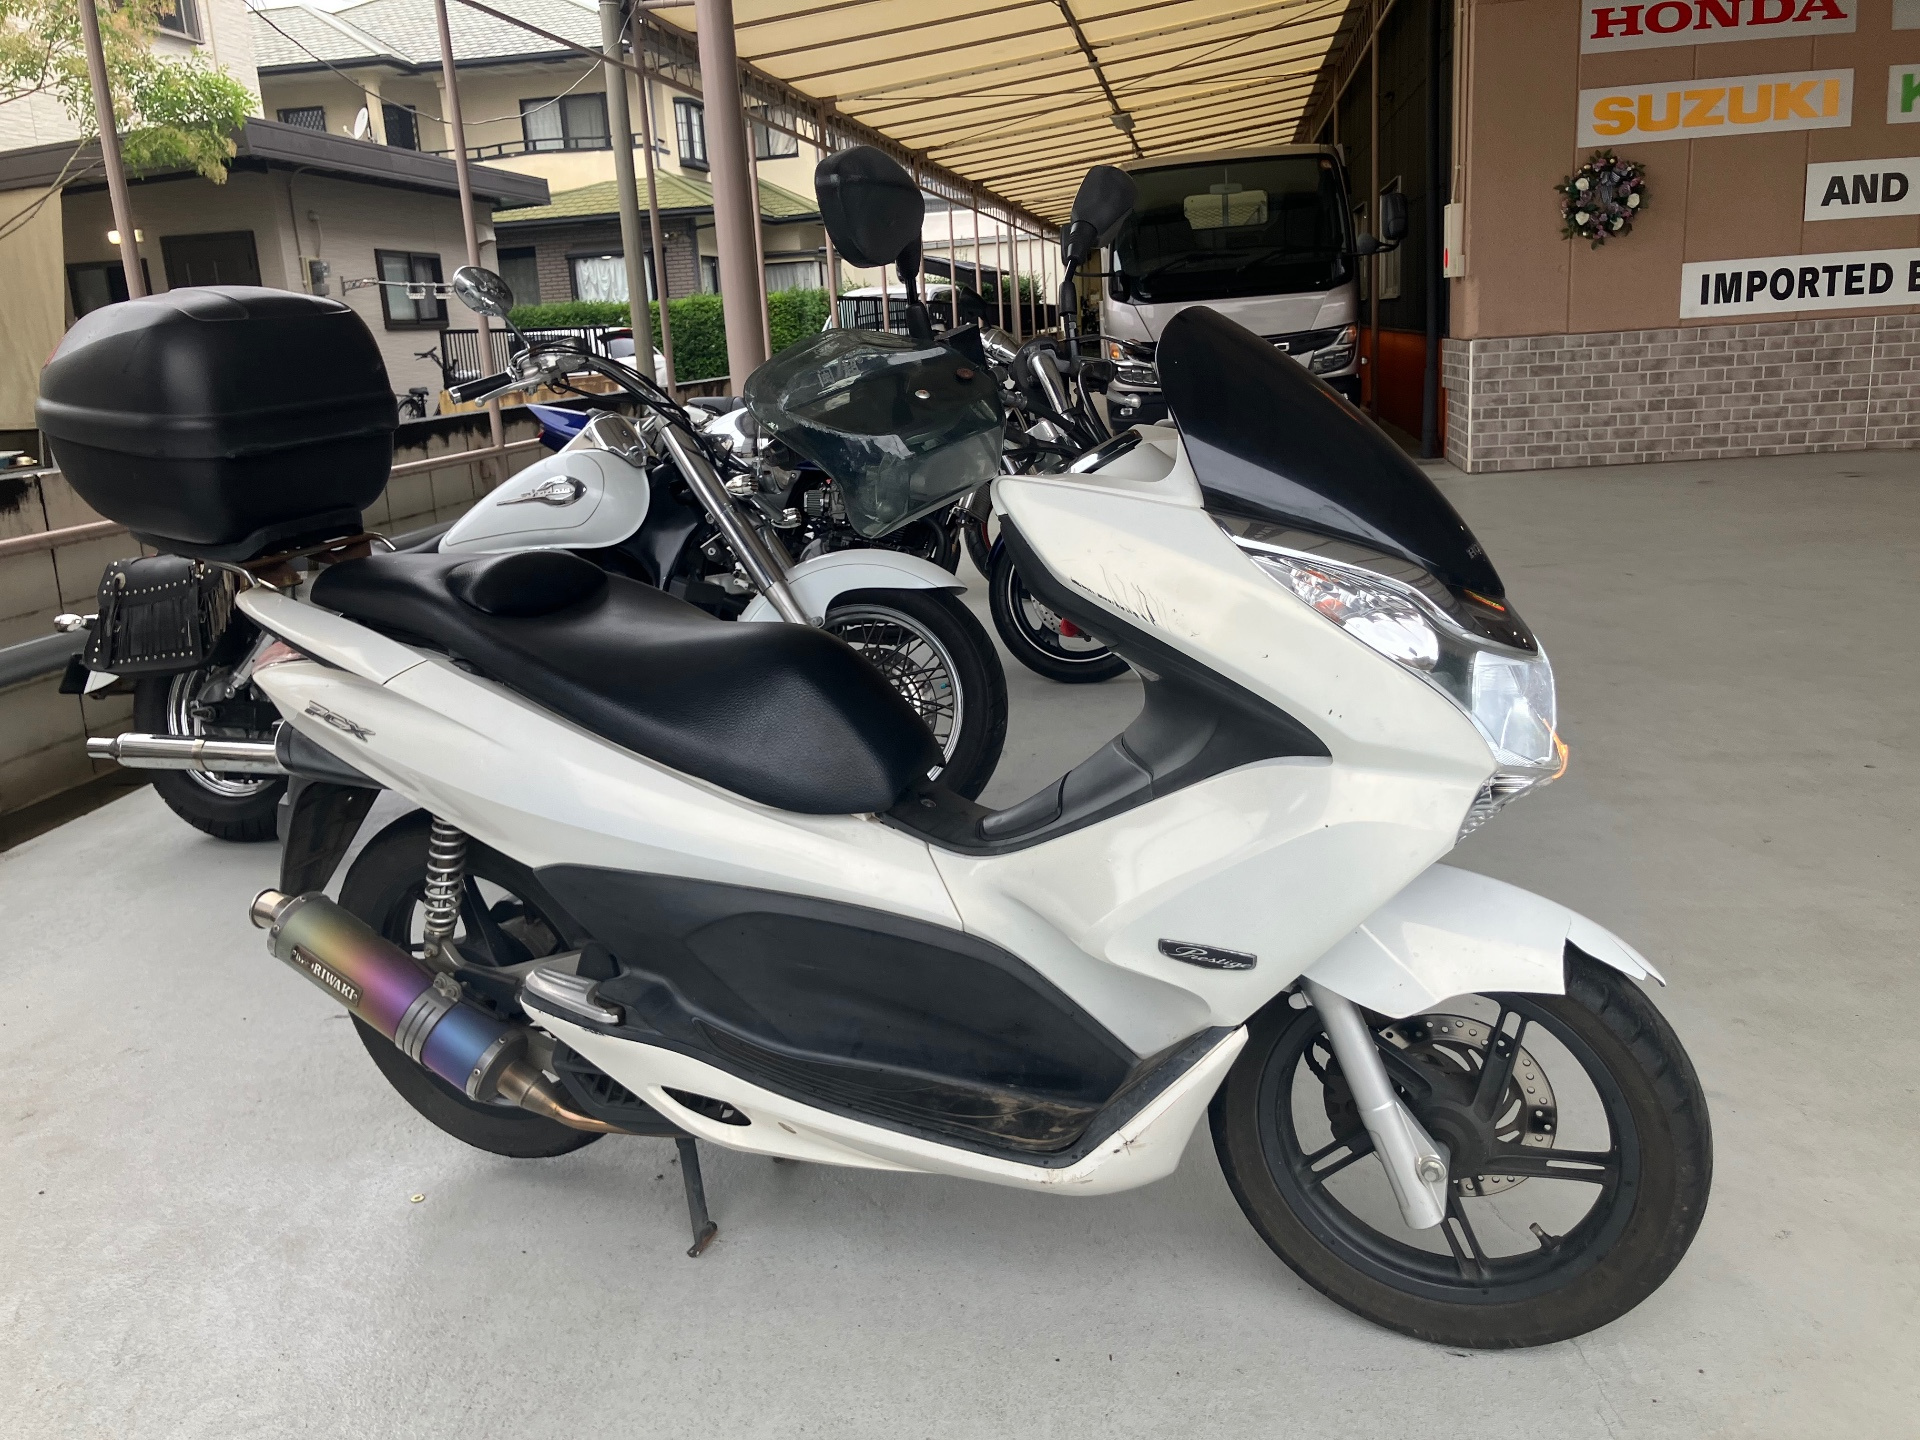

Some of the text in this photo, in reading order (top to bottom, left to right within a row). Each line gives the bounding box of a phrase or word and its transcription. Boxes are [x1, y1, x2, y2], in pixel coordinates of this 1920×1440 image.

[1590, 0, 1848, 39] HONDA
[1592, 79, 1840, 135] SUZUKI
[1820, 172, 1909, 207] AND
[1700, 262, 1894, 305] IMPORTED
[294, 951, 355, 1000] RIWAKI
